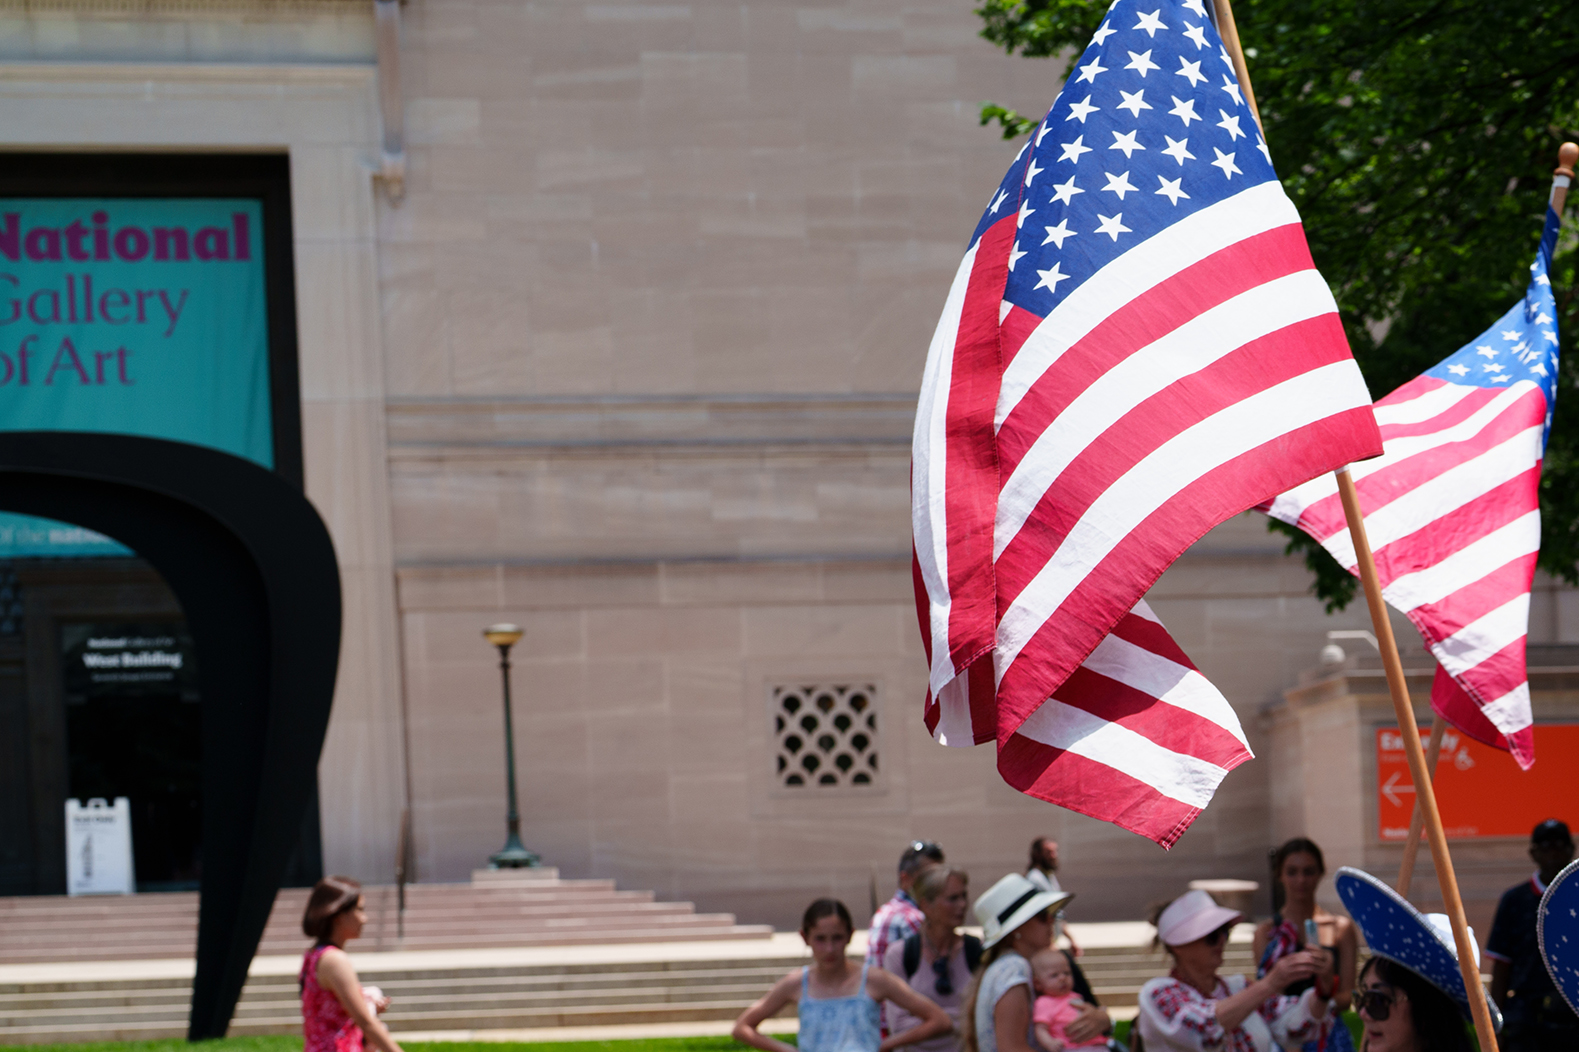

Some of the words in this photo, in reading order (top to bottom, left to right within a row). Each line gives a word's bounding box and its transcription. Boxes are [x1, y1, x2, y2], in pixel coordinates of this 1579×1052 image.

[43, 335, 136, 387] Art
[82, 651, 120, 669] West
[121, 650, 183, 669] Building
